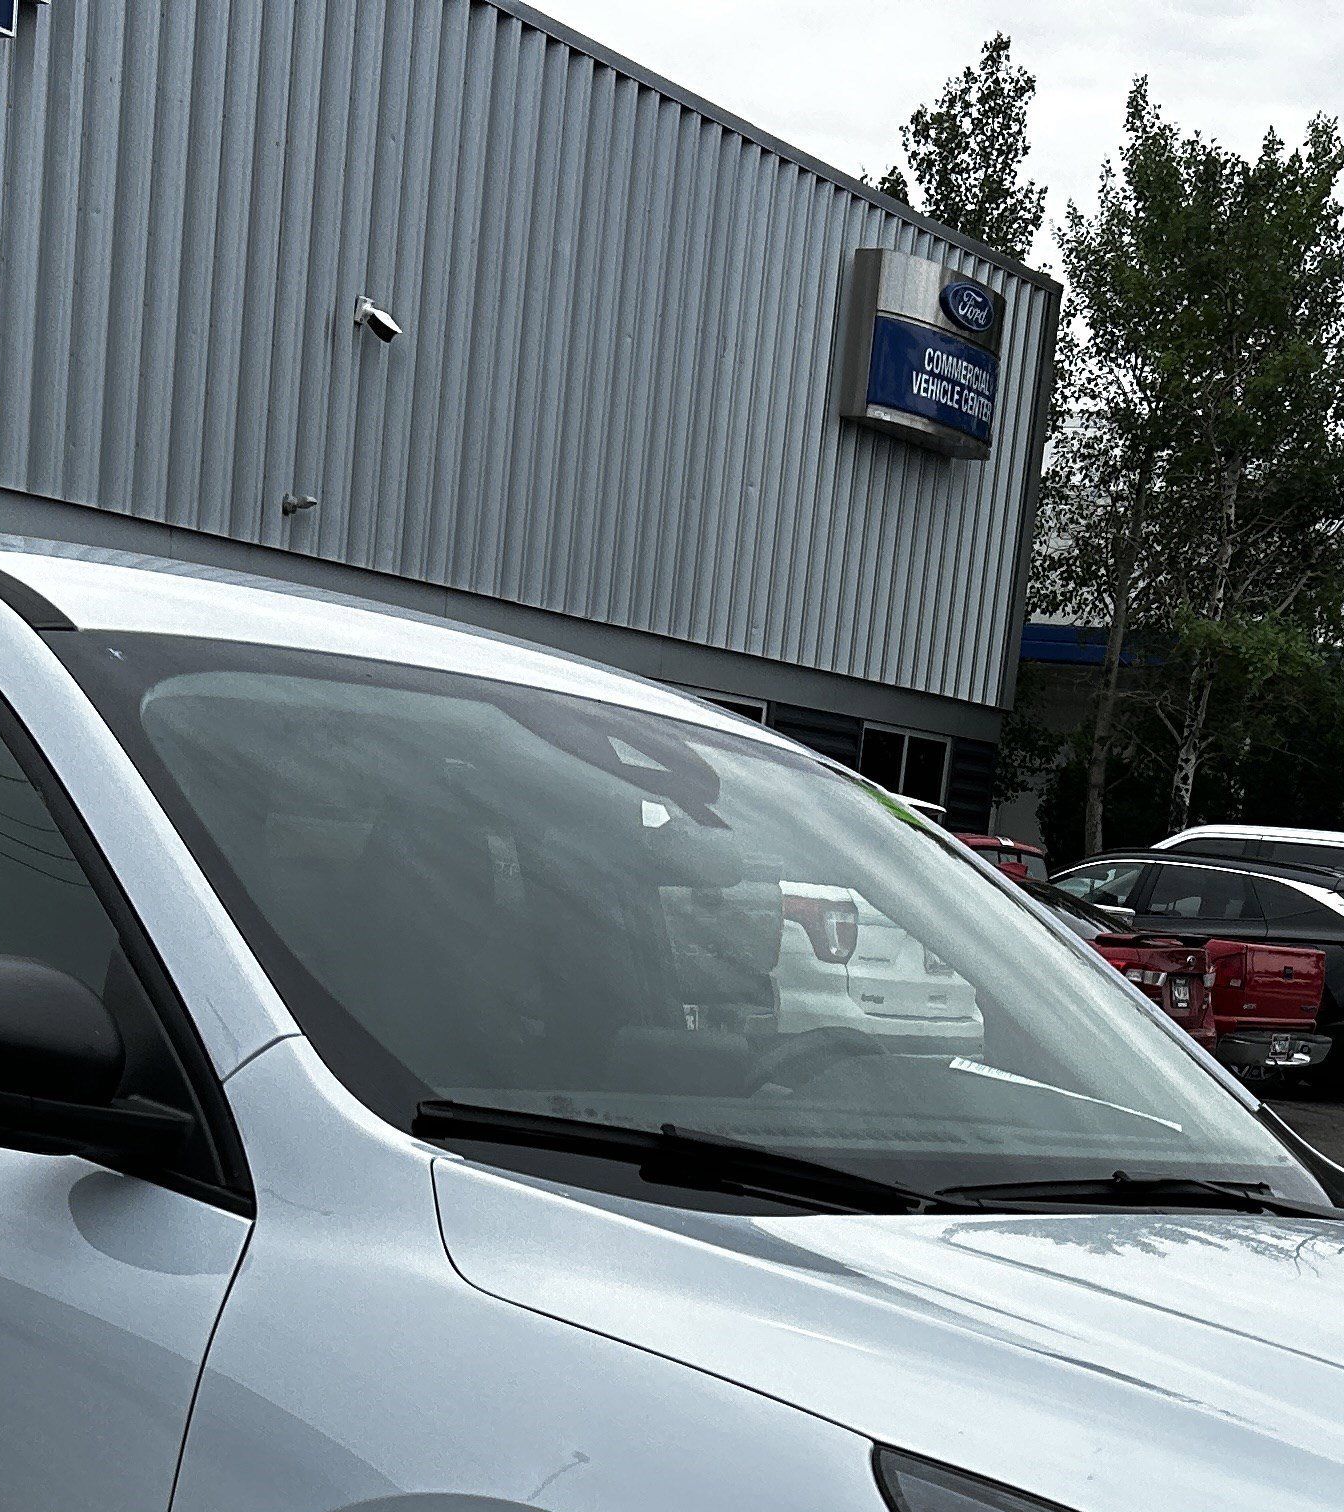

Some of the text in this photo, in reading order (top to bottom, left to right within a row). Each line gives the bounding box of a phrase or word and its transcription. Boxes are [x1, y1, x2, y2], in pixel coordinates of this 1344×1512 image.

[958, 290, 989, 326] Ford
[912, 370, 993, 422] VEHICLE CENTER
[924, 347, 992, 396] COMMERCIAL
